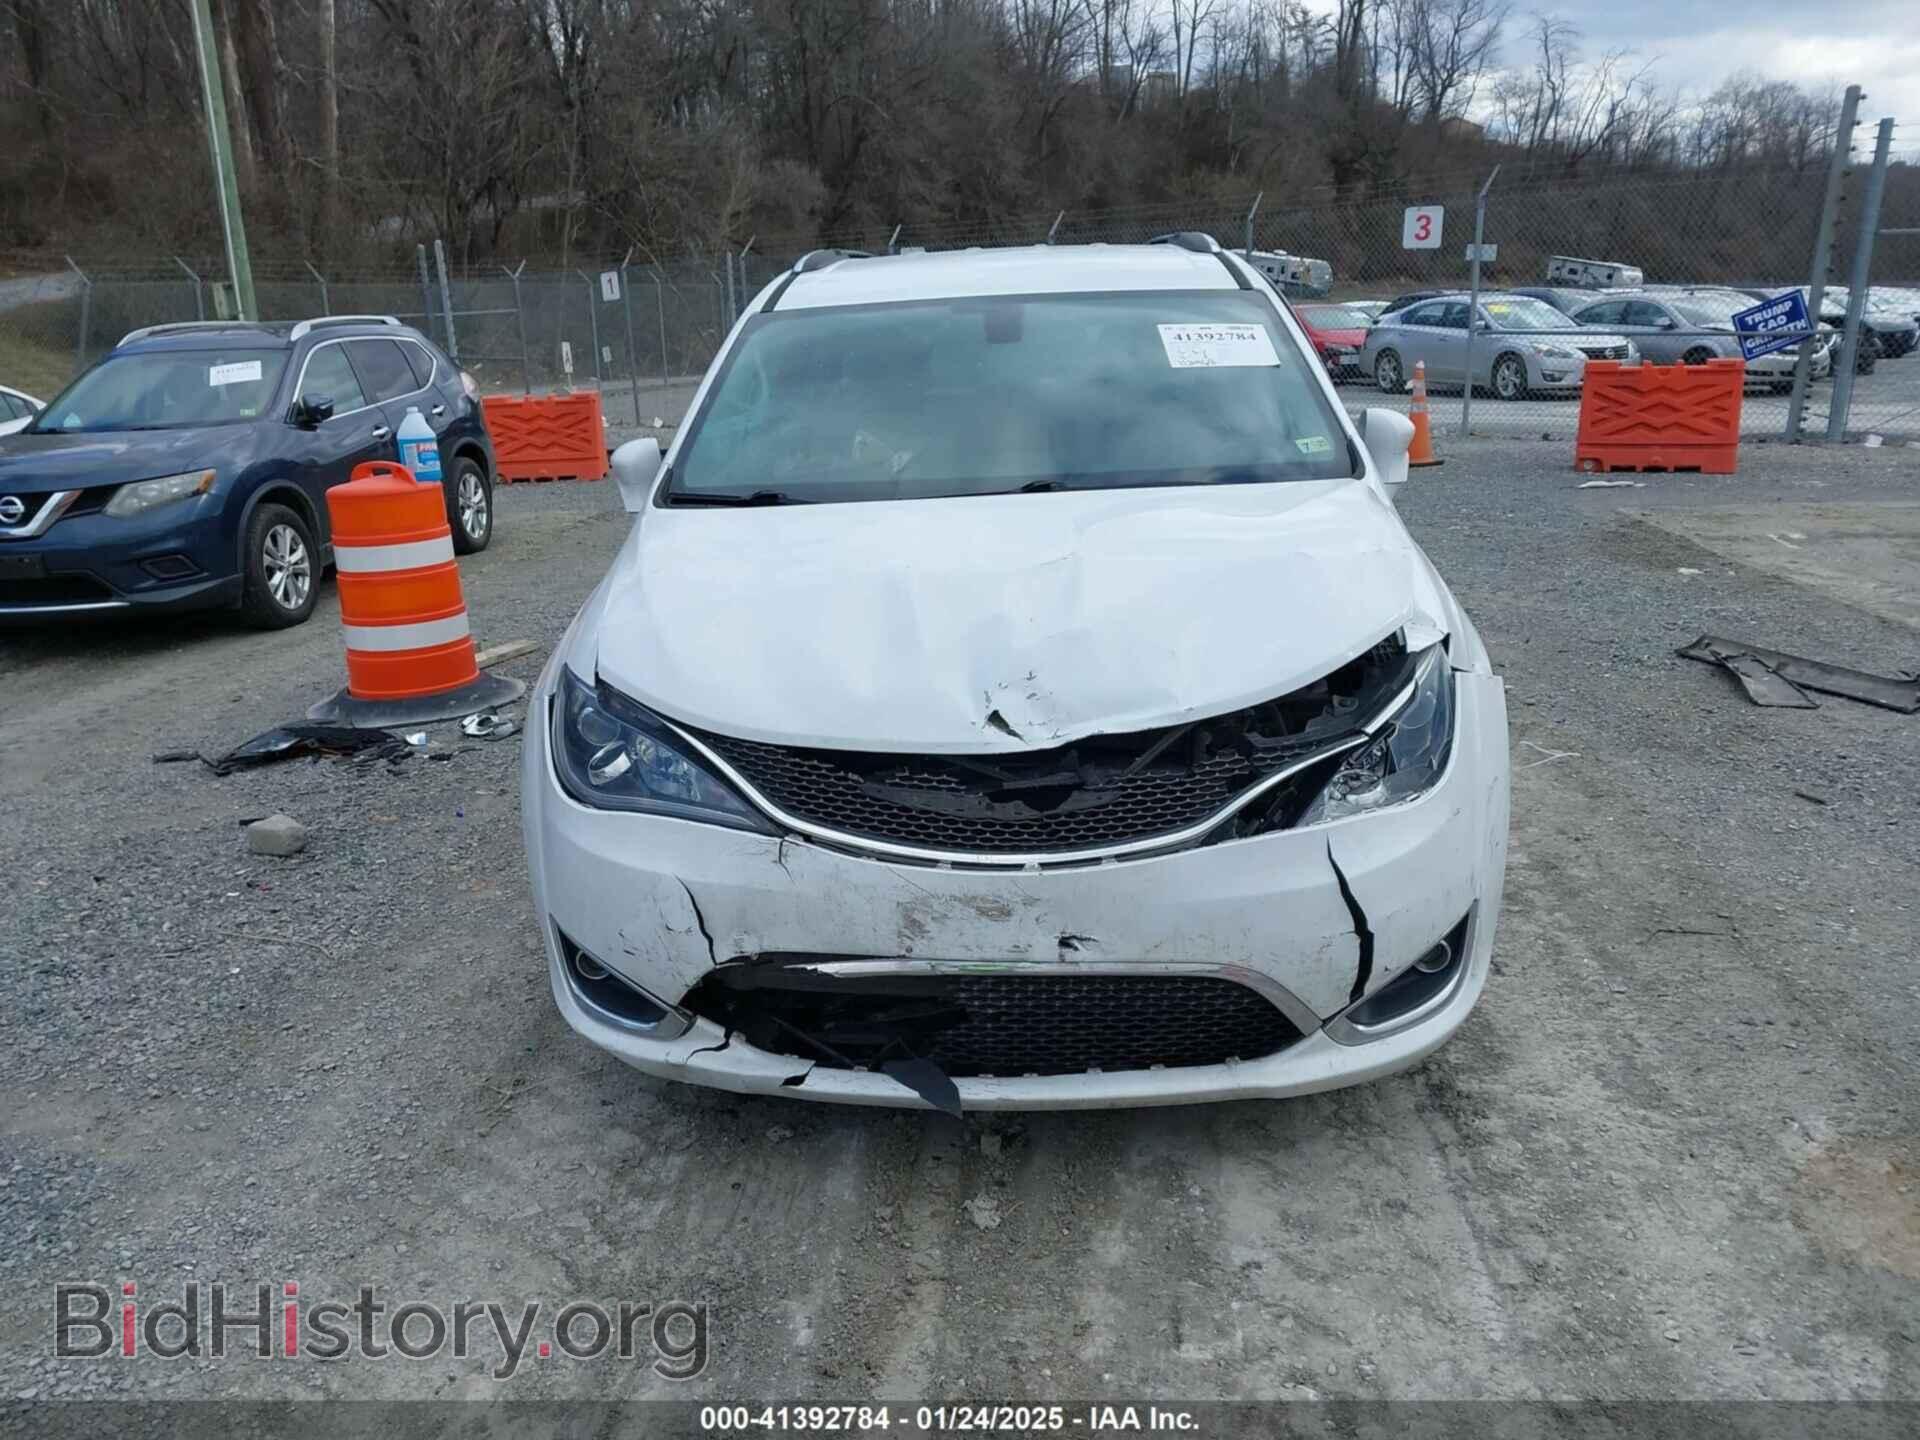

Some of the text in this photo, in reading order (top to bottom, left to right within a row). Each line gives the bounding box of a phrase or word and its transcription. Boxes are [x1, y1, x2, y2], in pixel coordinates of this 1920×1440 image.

[1414, 214, 1432, 241] 3
[1744, 300, 1793, 326] TRUMP
[1757, 314, 1788, 332] CAO
[1173, 332, 1257, 342] 41392784
